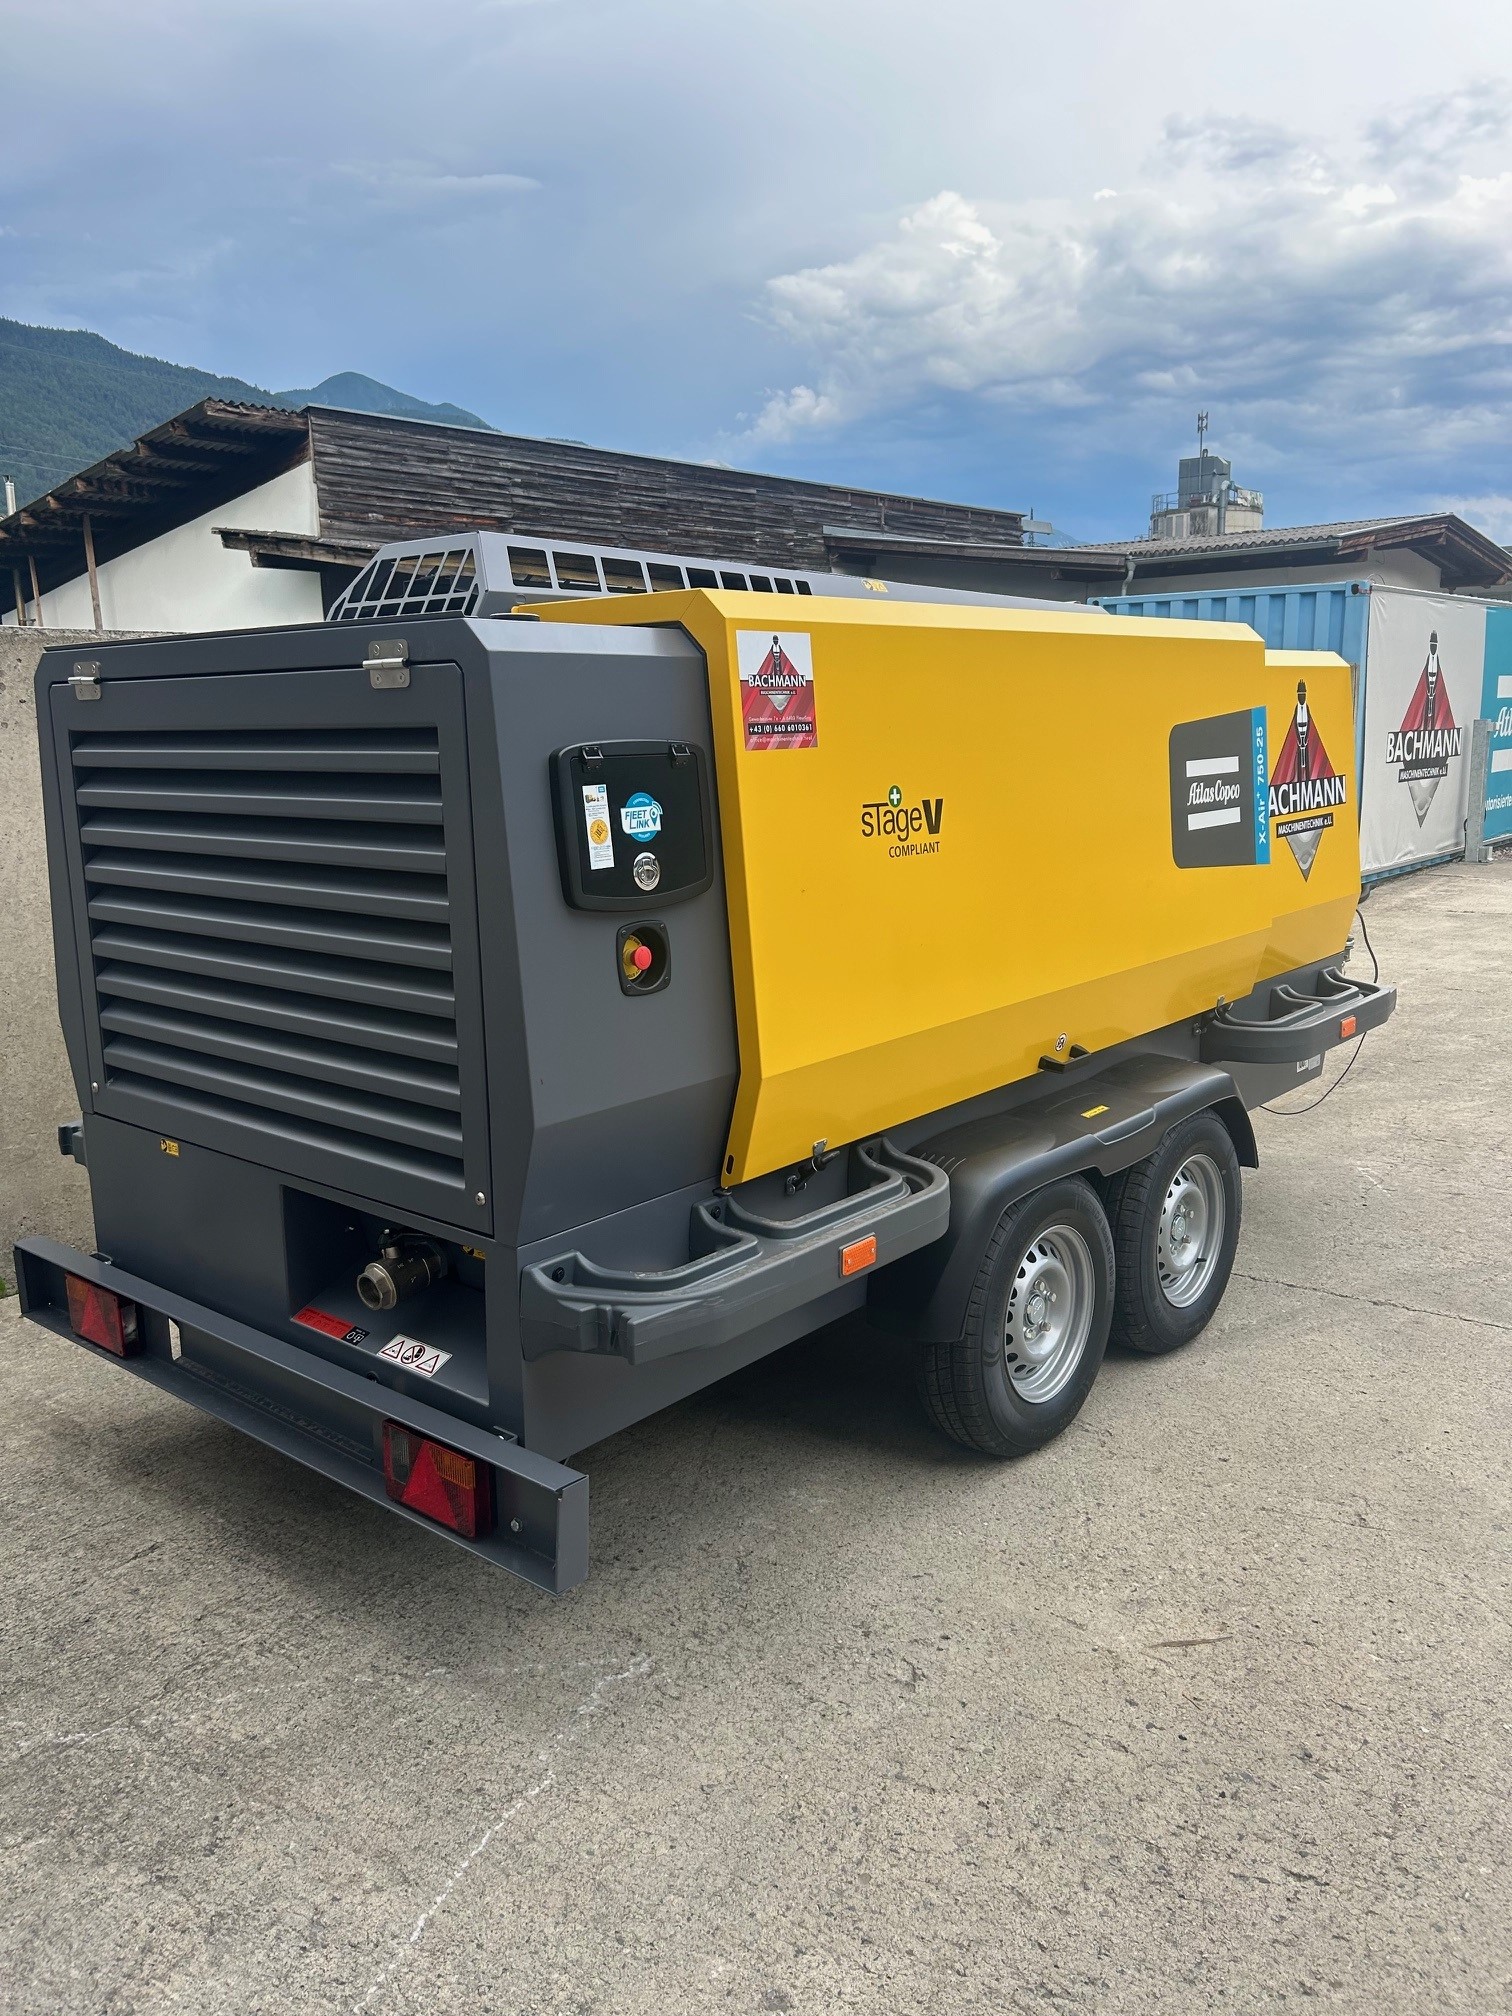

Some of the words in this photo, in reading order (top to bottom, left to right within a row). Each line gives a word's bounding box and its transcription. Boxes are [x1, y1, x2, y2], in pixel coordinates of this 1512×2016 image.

[748, 675, 806, 687] BACHMANN
[750, 725, 762, 733] +43
[763, 725, 772, 734] (0)
[787, 724, 812, 732] 6010361
[1256, 726, 1264, 785] 750-25
[1386, 728, 1462, 763] BACHMANN
[1187, 781, 1215, 806] Atlas
[1215, 779, 1240, 805] Copco
[1269, 775, 1346, 817] ACHMANN
[1278, 817, 1324, 836] MASCHINENTECHNIK
[889, 842, 940, 858] COMPLIANT
